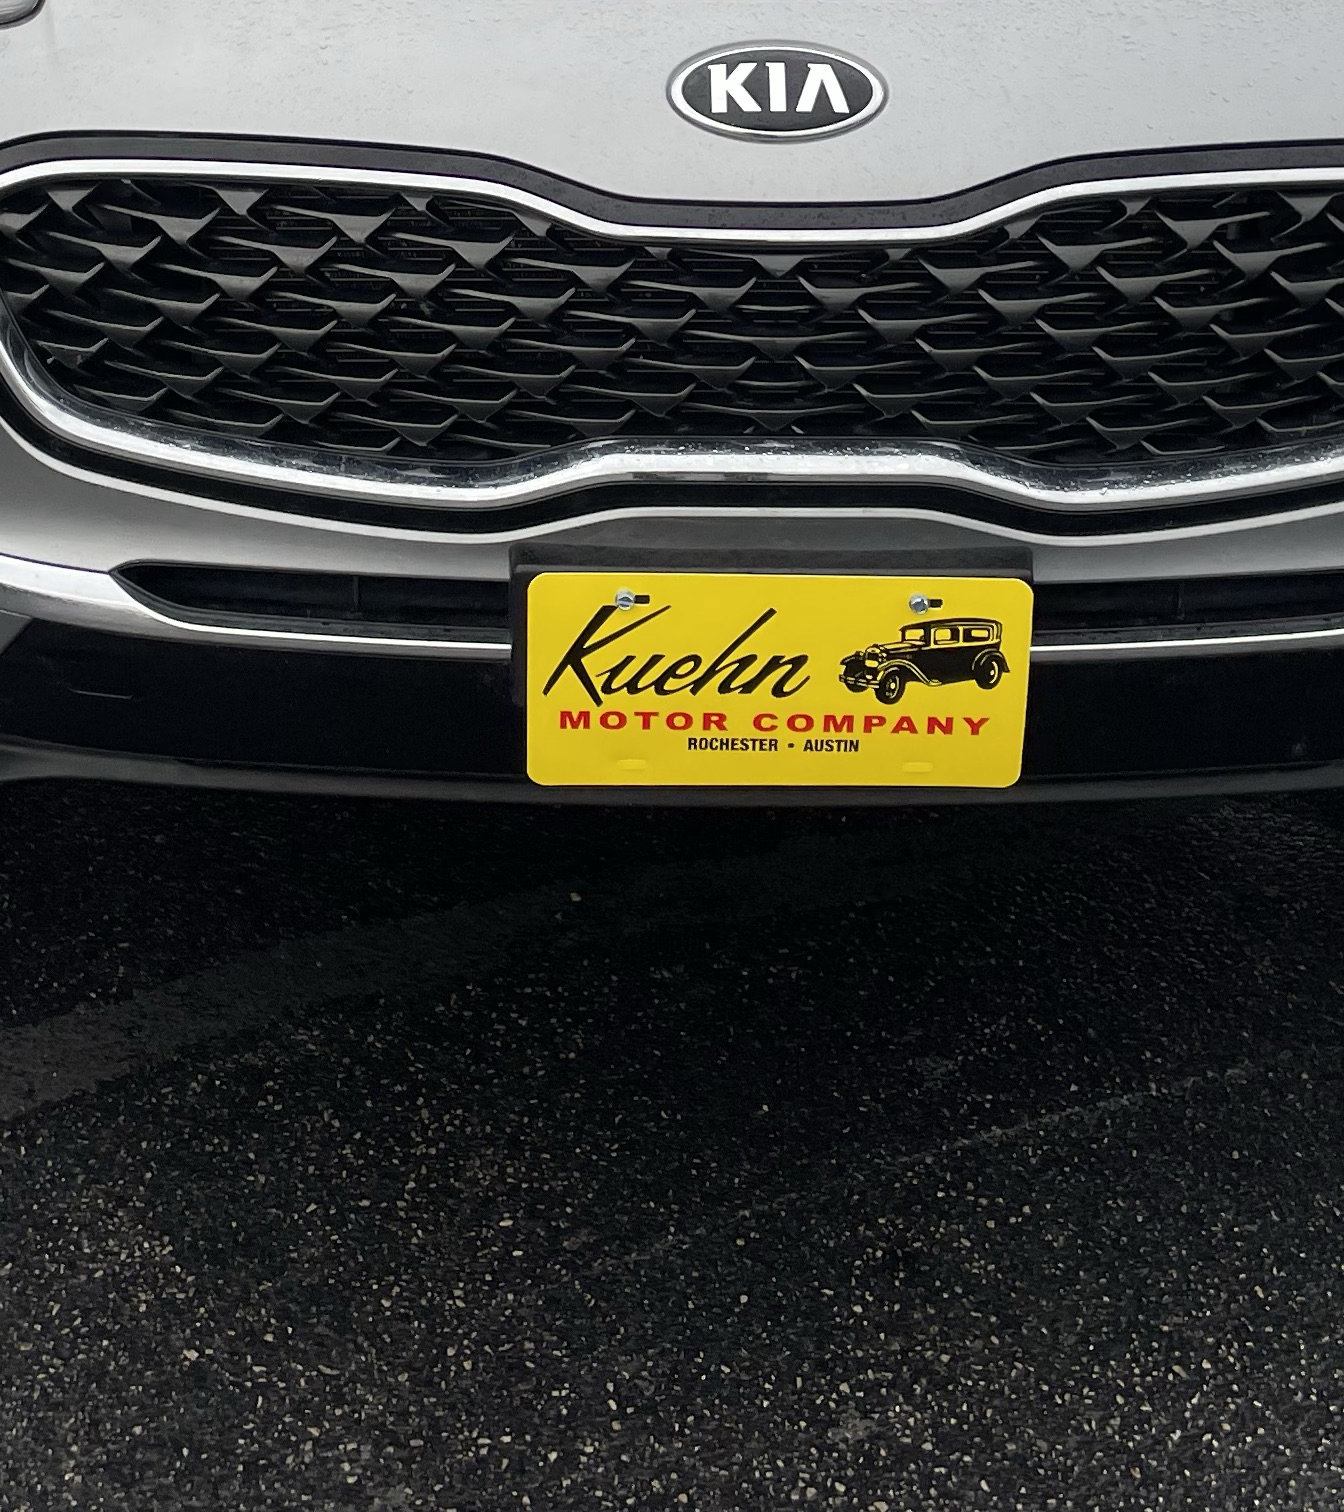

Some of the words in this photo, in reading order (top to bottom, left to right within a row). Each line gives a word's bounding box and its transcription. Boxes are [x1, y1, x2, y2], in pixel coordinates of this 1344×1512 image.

[708, 62, 850, 114] KIA
[542, 604, 811, 707] Kuehn
[559, 710, 729, 732] MOTOR
[752, 712, 992, 736] COMPANY
[687, 736, 779, 753] ROCHESTER
[803, 738, 860, 753] AUSTIN
